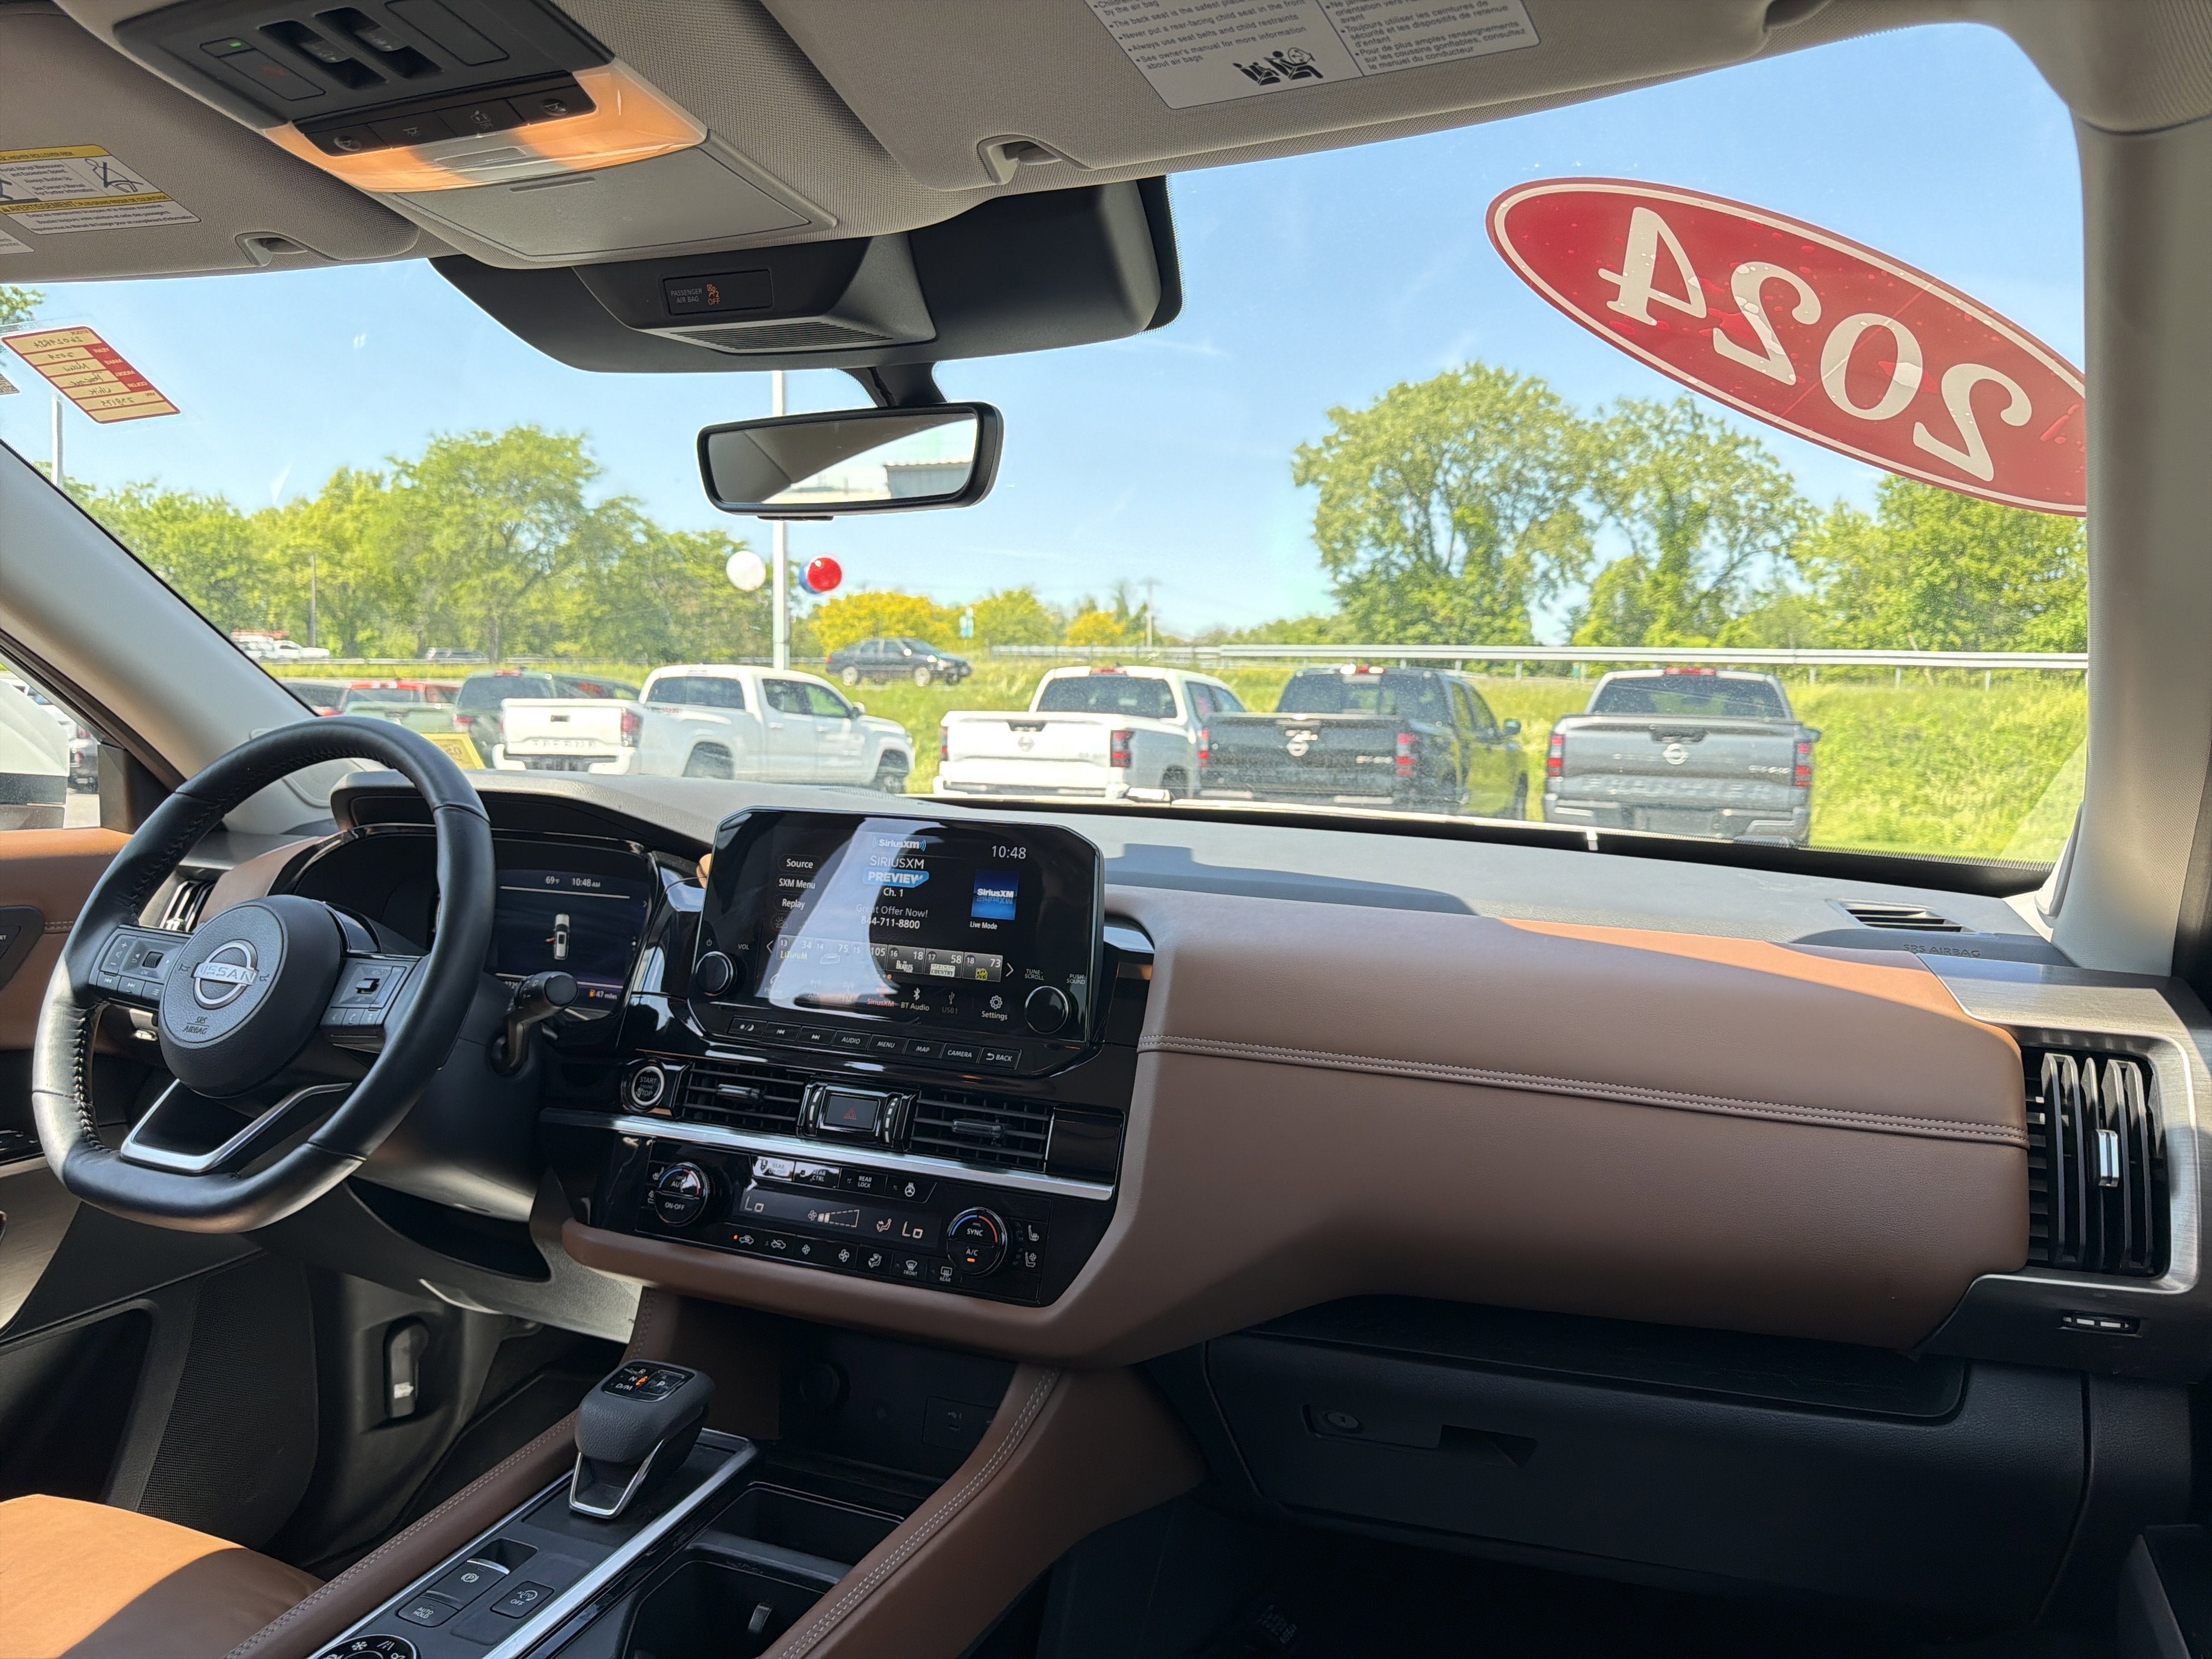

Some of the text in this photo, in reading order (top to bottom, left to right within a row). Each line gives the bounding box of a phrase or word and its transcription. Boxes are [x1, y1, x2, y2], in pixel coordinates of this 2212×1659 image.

[1130, 15, 1150, 24] back
[1152, 12, 1168, 20] seat
[1195, 1, 1220, 11] safest
[1335, 2, 1382, 16] orientation
[1122, 30, 1146, 40] Never
[1148, 27, 1161, 36] put
[1171, 16, 1215, 30] rear-facing
[1216, 12, 1236, 22] child
[1237, 8, 1256, 17] seat
[1268, 3, 1283, 11] the
[1340, 13, 1365, 24] avant
[1346, 21, 1383, 33] Toujours
[1384, 15, 1414, 26] utiliser
[1432, 2, 1475, 16] ceintures
[1350, 28, 1385, 41] sécurité
[1413, 14, 1457, 29] dispositifs
[1473, 5, 1509, 16] retenue
[1132, 41, 1160, 50] Always
[1196, 30, 1217, 39] belts
[1220, 26, 1235, 35] and
[1236, 22, 1257, 31] child
[1258, 13, 1299, 26] restraints
[1359, 47, 1380, 55] Pour
[1395, 41, 1413, 50] plus
[1414, 35, 1446, 46] amples
[1448, 21, 1519, 40] renseignements
[1140, 54, 1158, 63] See
[1159, 49, 1189, 59] owner's
[1191, 42, 1221, 53] manual
[1235, 36, 1257, 45] more
[1258, 25, 1307, 40] information
[1355, 35, 1392, 48] d'enfant
[1364, 55, 1378, 64] sur
[1395, 46, 1432, 58] coussins
[1434, 37, 1481, 52] gonflables,
[1483, 29, 1526, 42] consultez
[1147, 60, 1169, 70] about
[1182, 55, 1203, 63] bags
[1379, 57, 1411, 69] manuel
[1426, 46, 1475, 60] conducteur
[8, 201, 75, 212] AVERTISSEMENT
[670, 288, 703, 296] PASSENGER
[708, 297, 720, 306] OFF
[992, 845, 1026, 859] 10:48
[786, 858, 814, 868] Source
[870, 855, 924, 870] SIRIUSXM
[572, 878, 591, 887] 10:48
[778, 878, 815, 889] SXM Menu
[868, 871, 923, 884] PREVIEW
[883, 887, 904, 897] Ch. 1
[977, 888, 1014, 898] SiriusXM
[782, 898, 805, 911] Replay
[856, 904, 928, 918] Great Offer Now!
[861, 916, 920, 929] 844-711-8800
[981, 922, 998, 930] Mode
[802, 940, 812, 949] 34
[838, 944, 849, 953] 75
[871, 947, 886, 957] 105
[913, 951, 924, 961] 18
[950, 955, 962, 964] 58
[990, 958, 1001, 968] 73
[1903, 944, 1980, 957] SRS AIRBAG
[198, 964, 254, 983] NISSAN
[867, 998, 895, 1007] SiriusXM
[910, 1003, 930, 1012] Audio
[941, 1006, 958, 1014] USB1
[981, 1010, 1008, 1022] Settings
[182, 1025, 210, 1035] AIRBAG
[841, 1036, 861, 1045] AUDIO
[947, 1049, 973, 1058] CAMERA
[967, 1228, 984, 1237] SYNC
[966, 1248, 979, 1256] A/C
[615, 1383, 634, 1391] D/M
[413, 1610, 430, 1620] HOLD
[417, 1606, 434, 1615] AUTO
